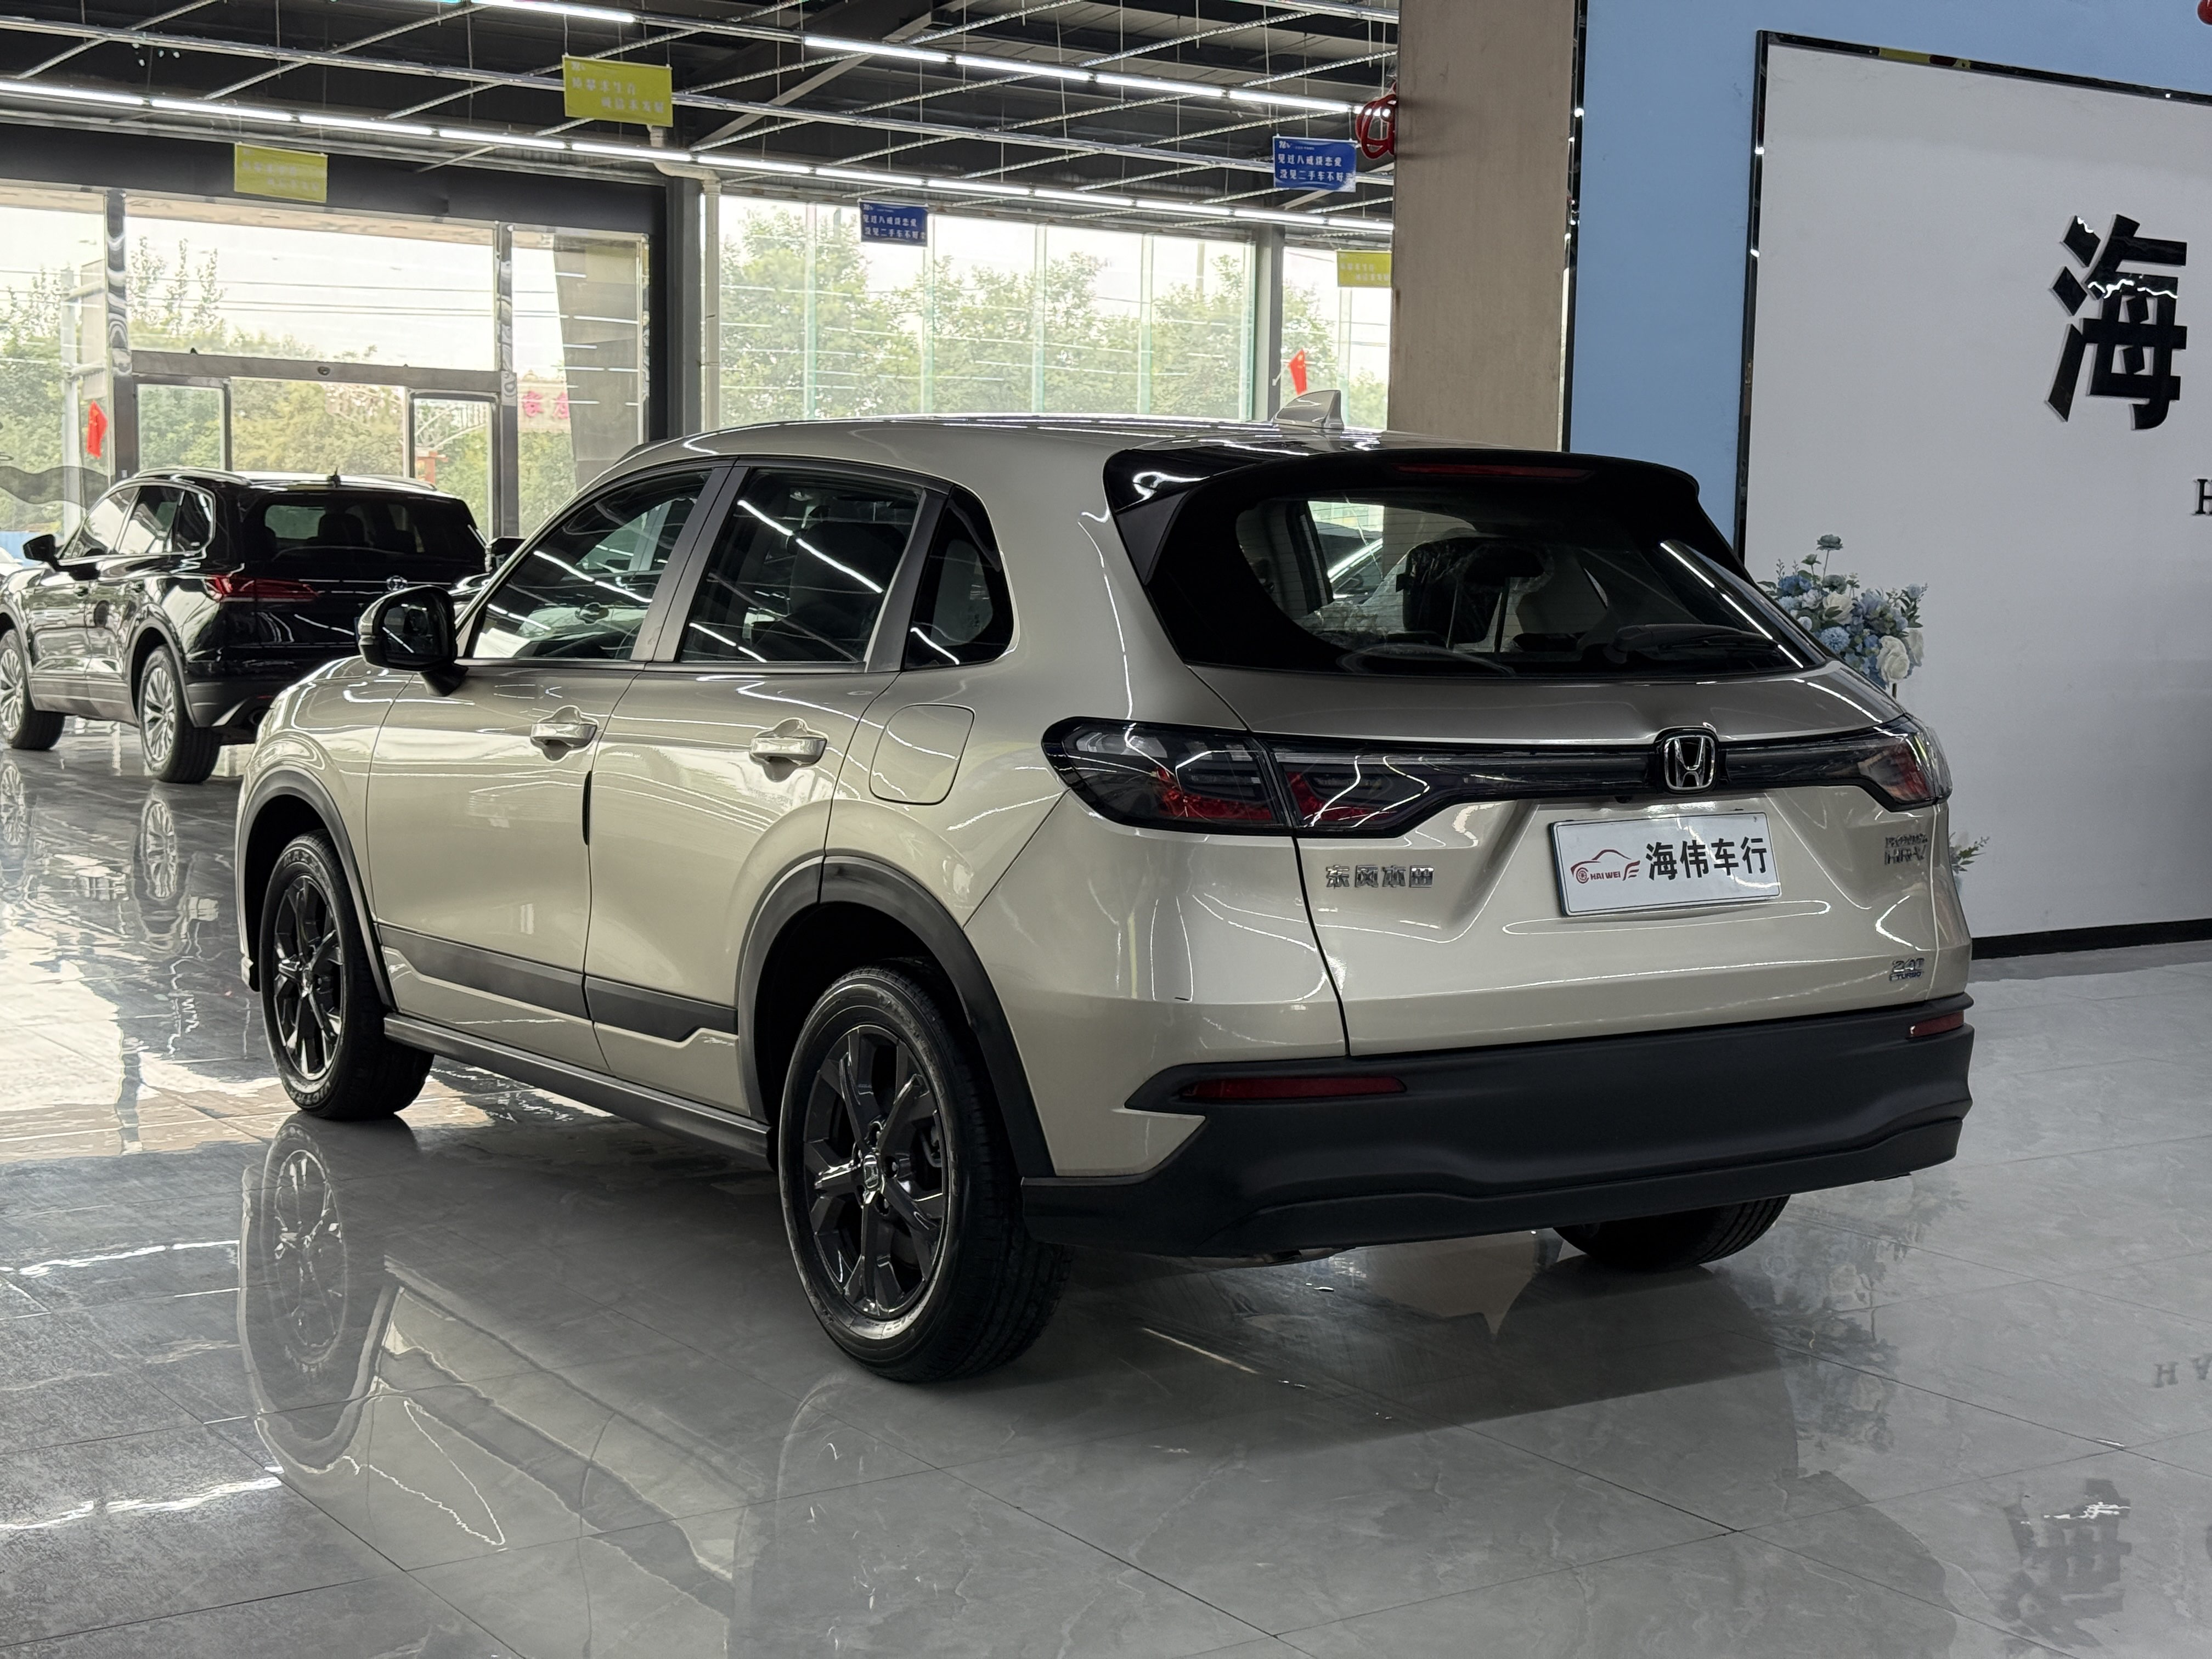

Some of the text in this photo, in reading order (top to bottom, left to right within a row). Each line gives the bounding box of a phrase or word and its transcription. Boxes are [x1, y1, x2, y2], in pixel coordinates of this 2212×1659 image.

[2045, 214, 2187, 430] 海
[1325, 865, 1435, 889] 东风本田
[1646, 837, 1768, 881] 海伟车行
